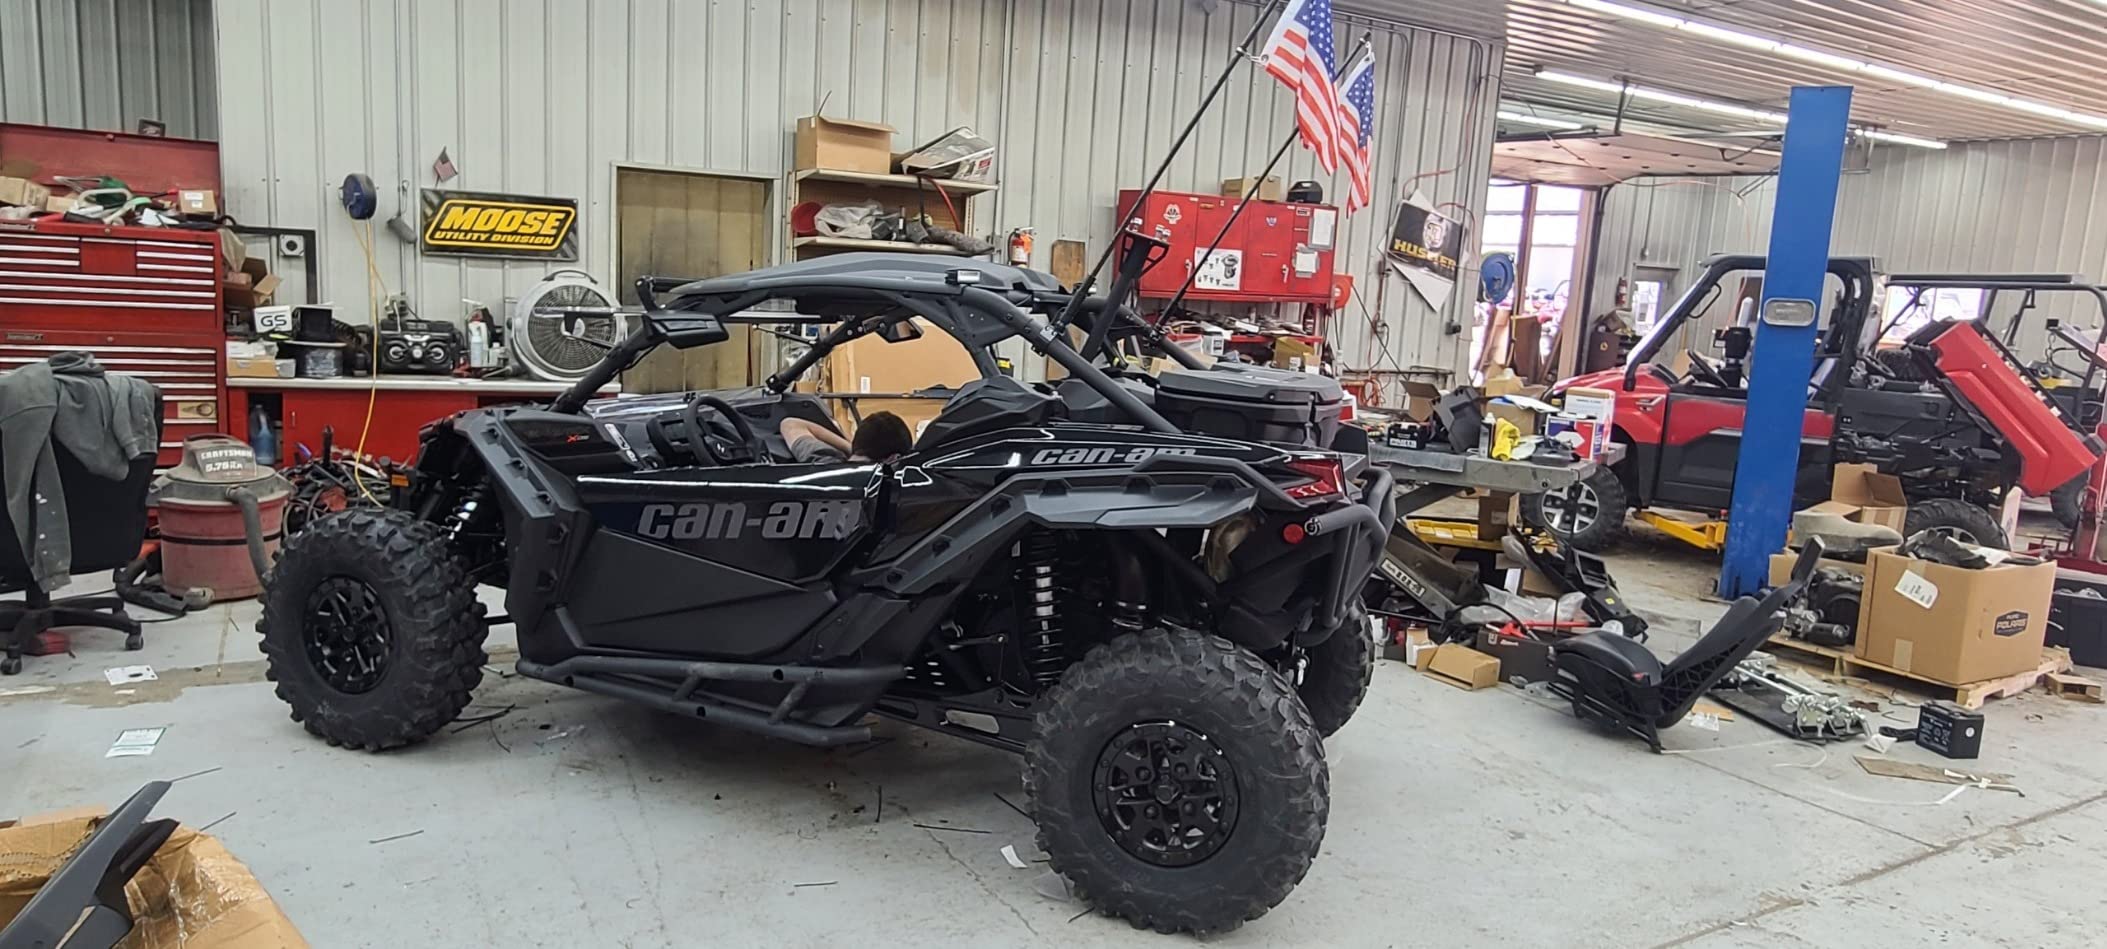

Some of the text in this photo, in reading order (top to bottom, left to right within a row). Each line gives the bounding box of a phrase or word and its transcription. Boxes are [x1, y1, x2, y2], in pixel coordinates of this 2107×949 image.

[440, 206, 566, 235] MOOSE
[434, 231, 555, 245] UTILITY DIVISION
[260, 314, 288, 328] GS
[637, 500, 862, 540] can-am
